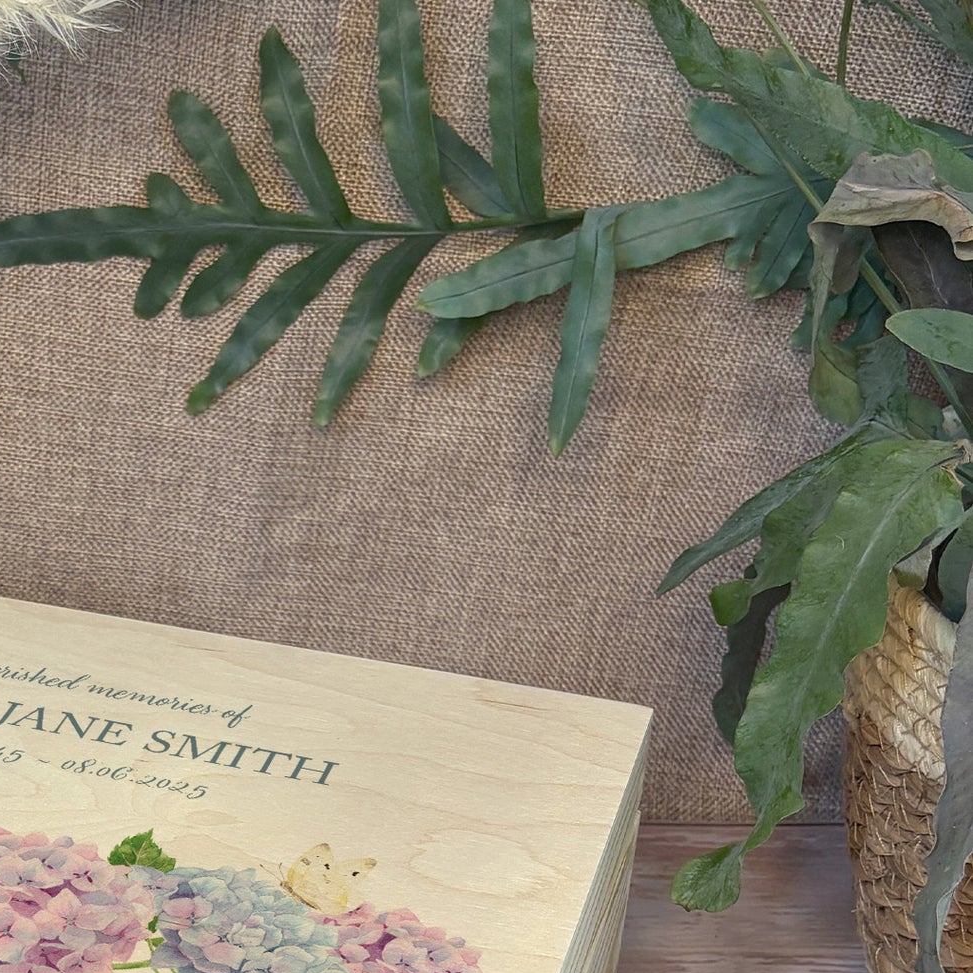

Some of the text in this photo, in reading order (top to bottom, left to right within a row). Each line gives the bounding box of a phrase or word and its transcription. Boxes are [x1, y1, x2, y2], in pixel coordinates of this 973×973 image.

[87, 683, 216, 716] memories
[221, 704, 252, 728] of
[60, 758, 207, 801] 08.06.2025
[142, 730, 339, 786] SMITH
